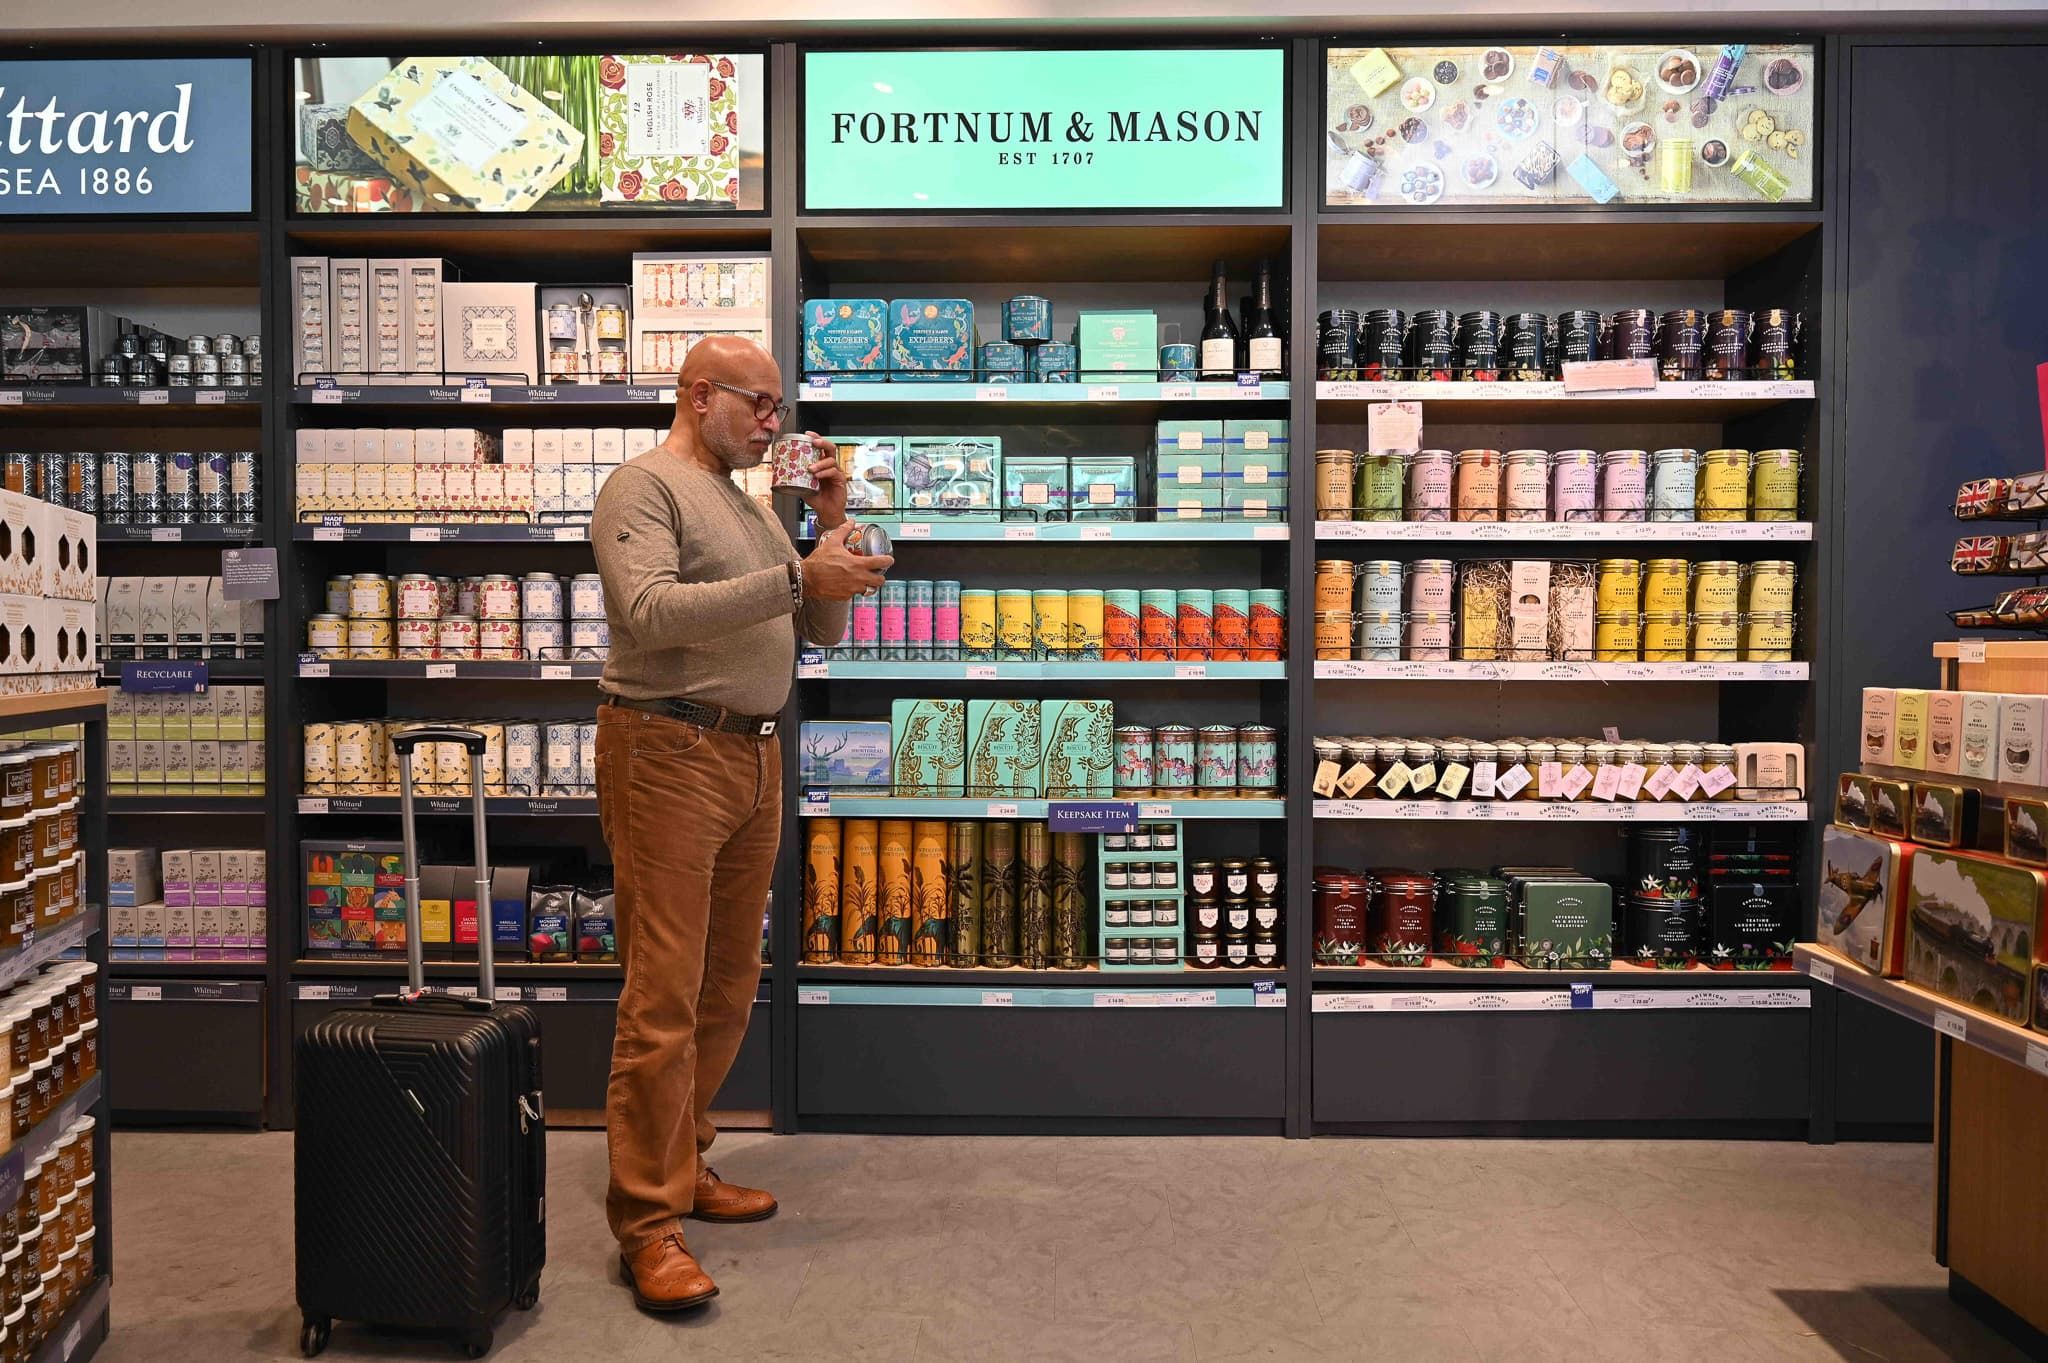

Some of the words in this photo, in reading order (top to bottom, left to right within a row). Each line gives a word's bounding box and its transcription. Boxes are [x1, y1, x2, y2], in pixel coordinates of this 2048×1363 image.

[0, 82, 194, 154] ttard
[831, 111, 1053, 144] FORTNUM
[1065, 111, 1095, 144] &
[1107, 110, 1263, 142] MASON
[999, 152, 1038, 165] EST
[1051, 152, 1095, 165] 1707
[80, 167, 154, 195] 1886
[528, 389, 558, 397] Whittard
[626, 389, 657, 397] Whittard
[125, 527, 152, 535] Whittar
[136, 670, 192, 678] RECYCLABLE
[1541, 665, 1582, 675] CARTWRIGHT
[332, 800, 362, 808] Whittard
[430, 801, 460, 809] Whittard
[528, 801, 558, 810] Whittard
[1057, 809, 1103, 819] KEEPSAKE
[1106, 809, 1130, 819] ITEM
[1539, 805, 1580, 815] CARTWRIGHT
[1757, 806, 1798, 815] CARTWRIGHT
[1742, 897, 1773, 906] CARTWRIGHT
[109, 985, 126, 993] ttard
[193, 986, 222, 995] Whittard
[1468, 995, 1509, 1005] CARTWRIGHT
[1686, 992, 1728, 1003] CARTWRIGHT
